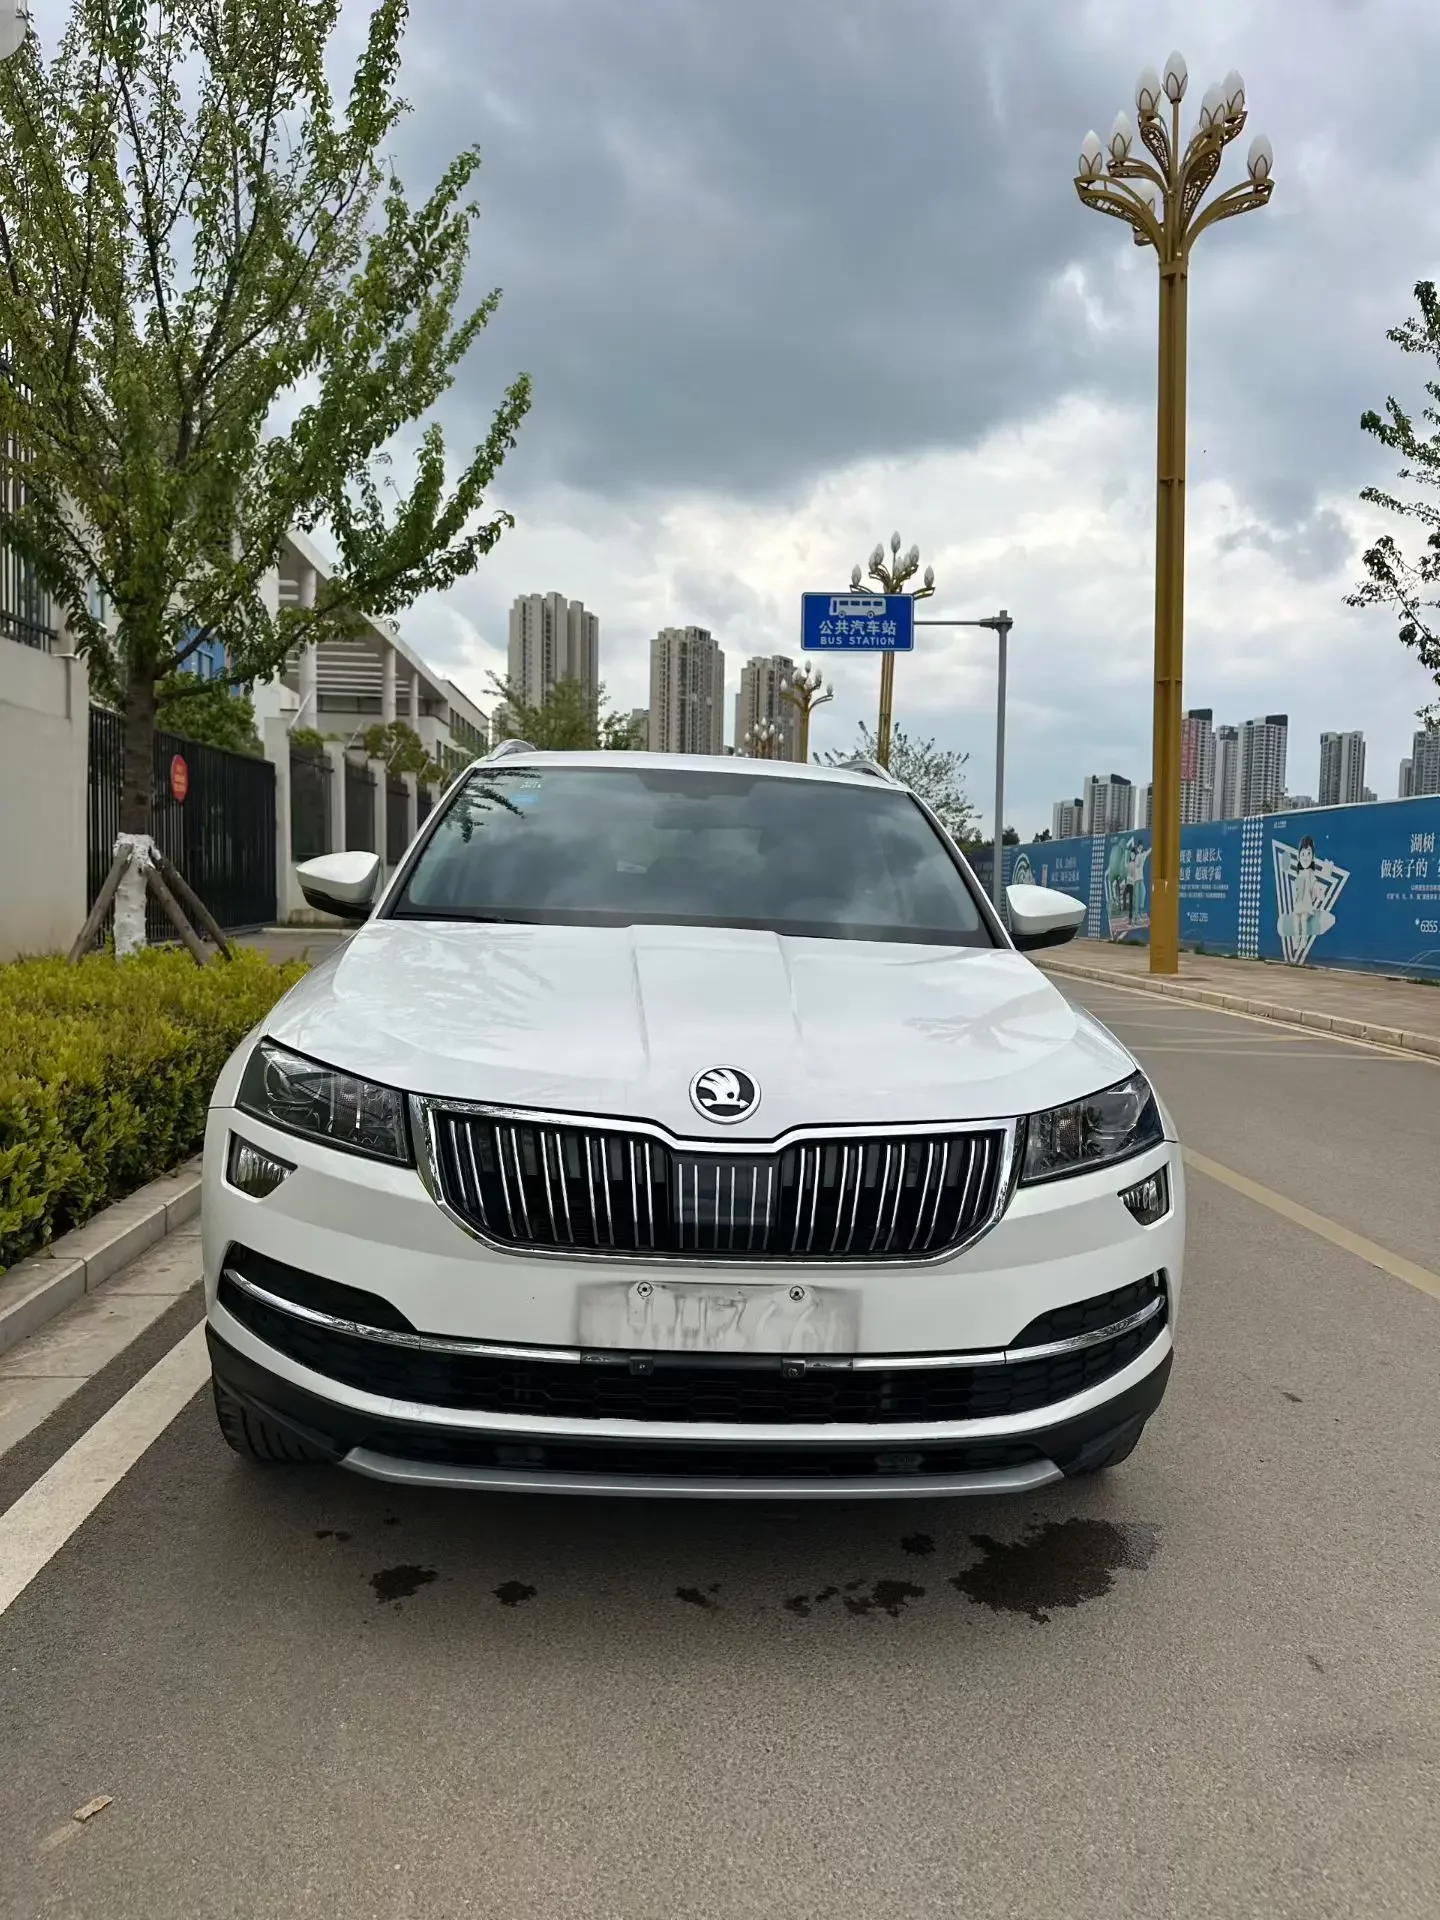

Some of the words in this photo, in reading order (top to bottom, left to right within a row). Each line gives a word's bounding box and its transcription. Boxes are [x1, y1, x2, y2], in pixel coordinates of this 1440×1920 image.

[818, 619, 897, 636] 公共汽车站
[820, 636, 843, 645] BUS
[848, 636, 895, 646] STATION
